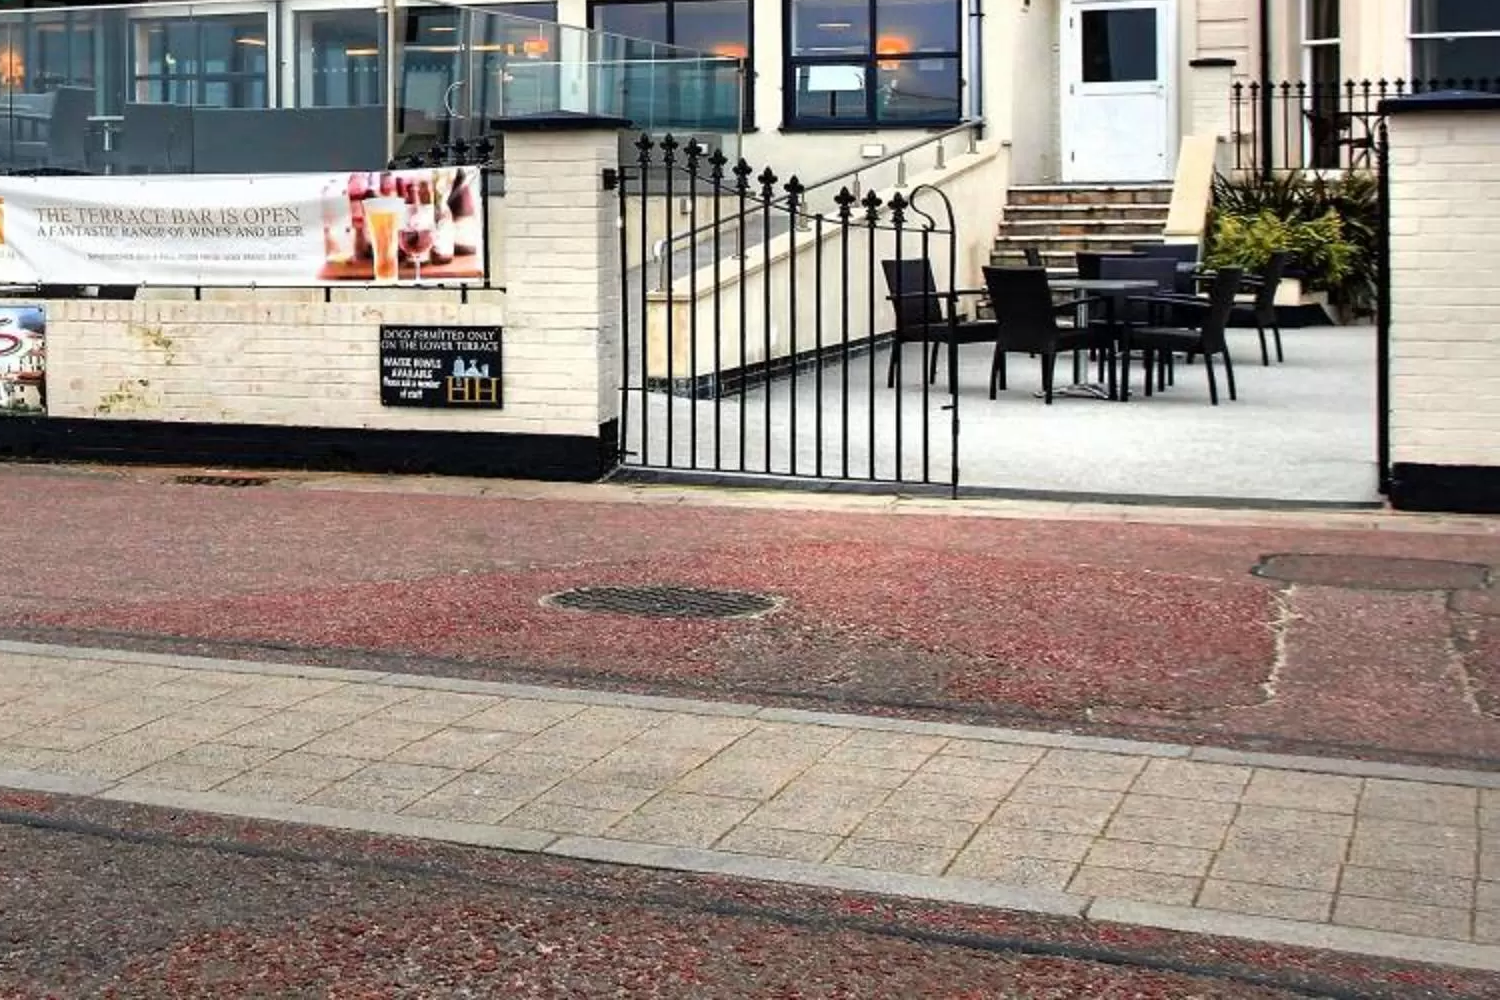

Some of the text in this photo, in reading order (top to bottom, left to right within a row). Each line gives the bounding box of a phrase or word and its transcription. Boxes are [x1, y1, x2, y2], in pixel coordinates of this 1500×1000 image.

[34, 207, 301, 225] THE TERRACE BAR IS OPEN
[37, 225, 47, 237] A
[49, 225, 118, 238] FANTASTIC
[189, 226, 232, 238] WINES
[236, 226, 265, 238] AND
[383, 328, 496, 341] DOGS PERMITTED ONLY
[420, 341, 453, 351] LOWER
[456, 341, 499, 352] TERRACE
